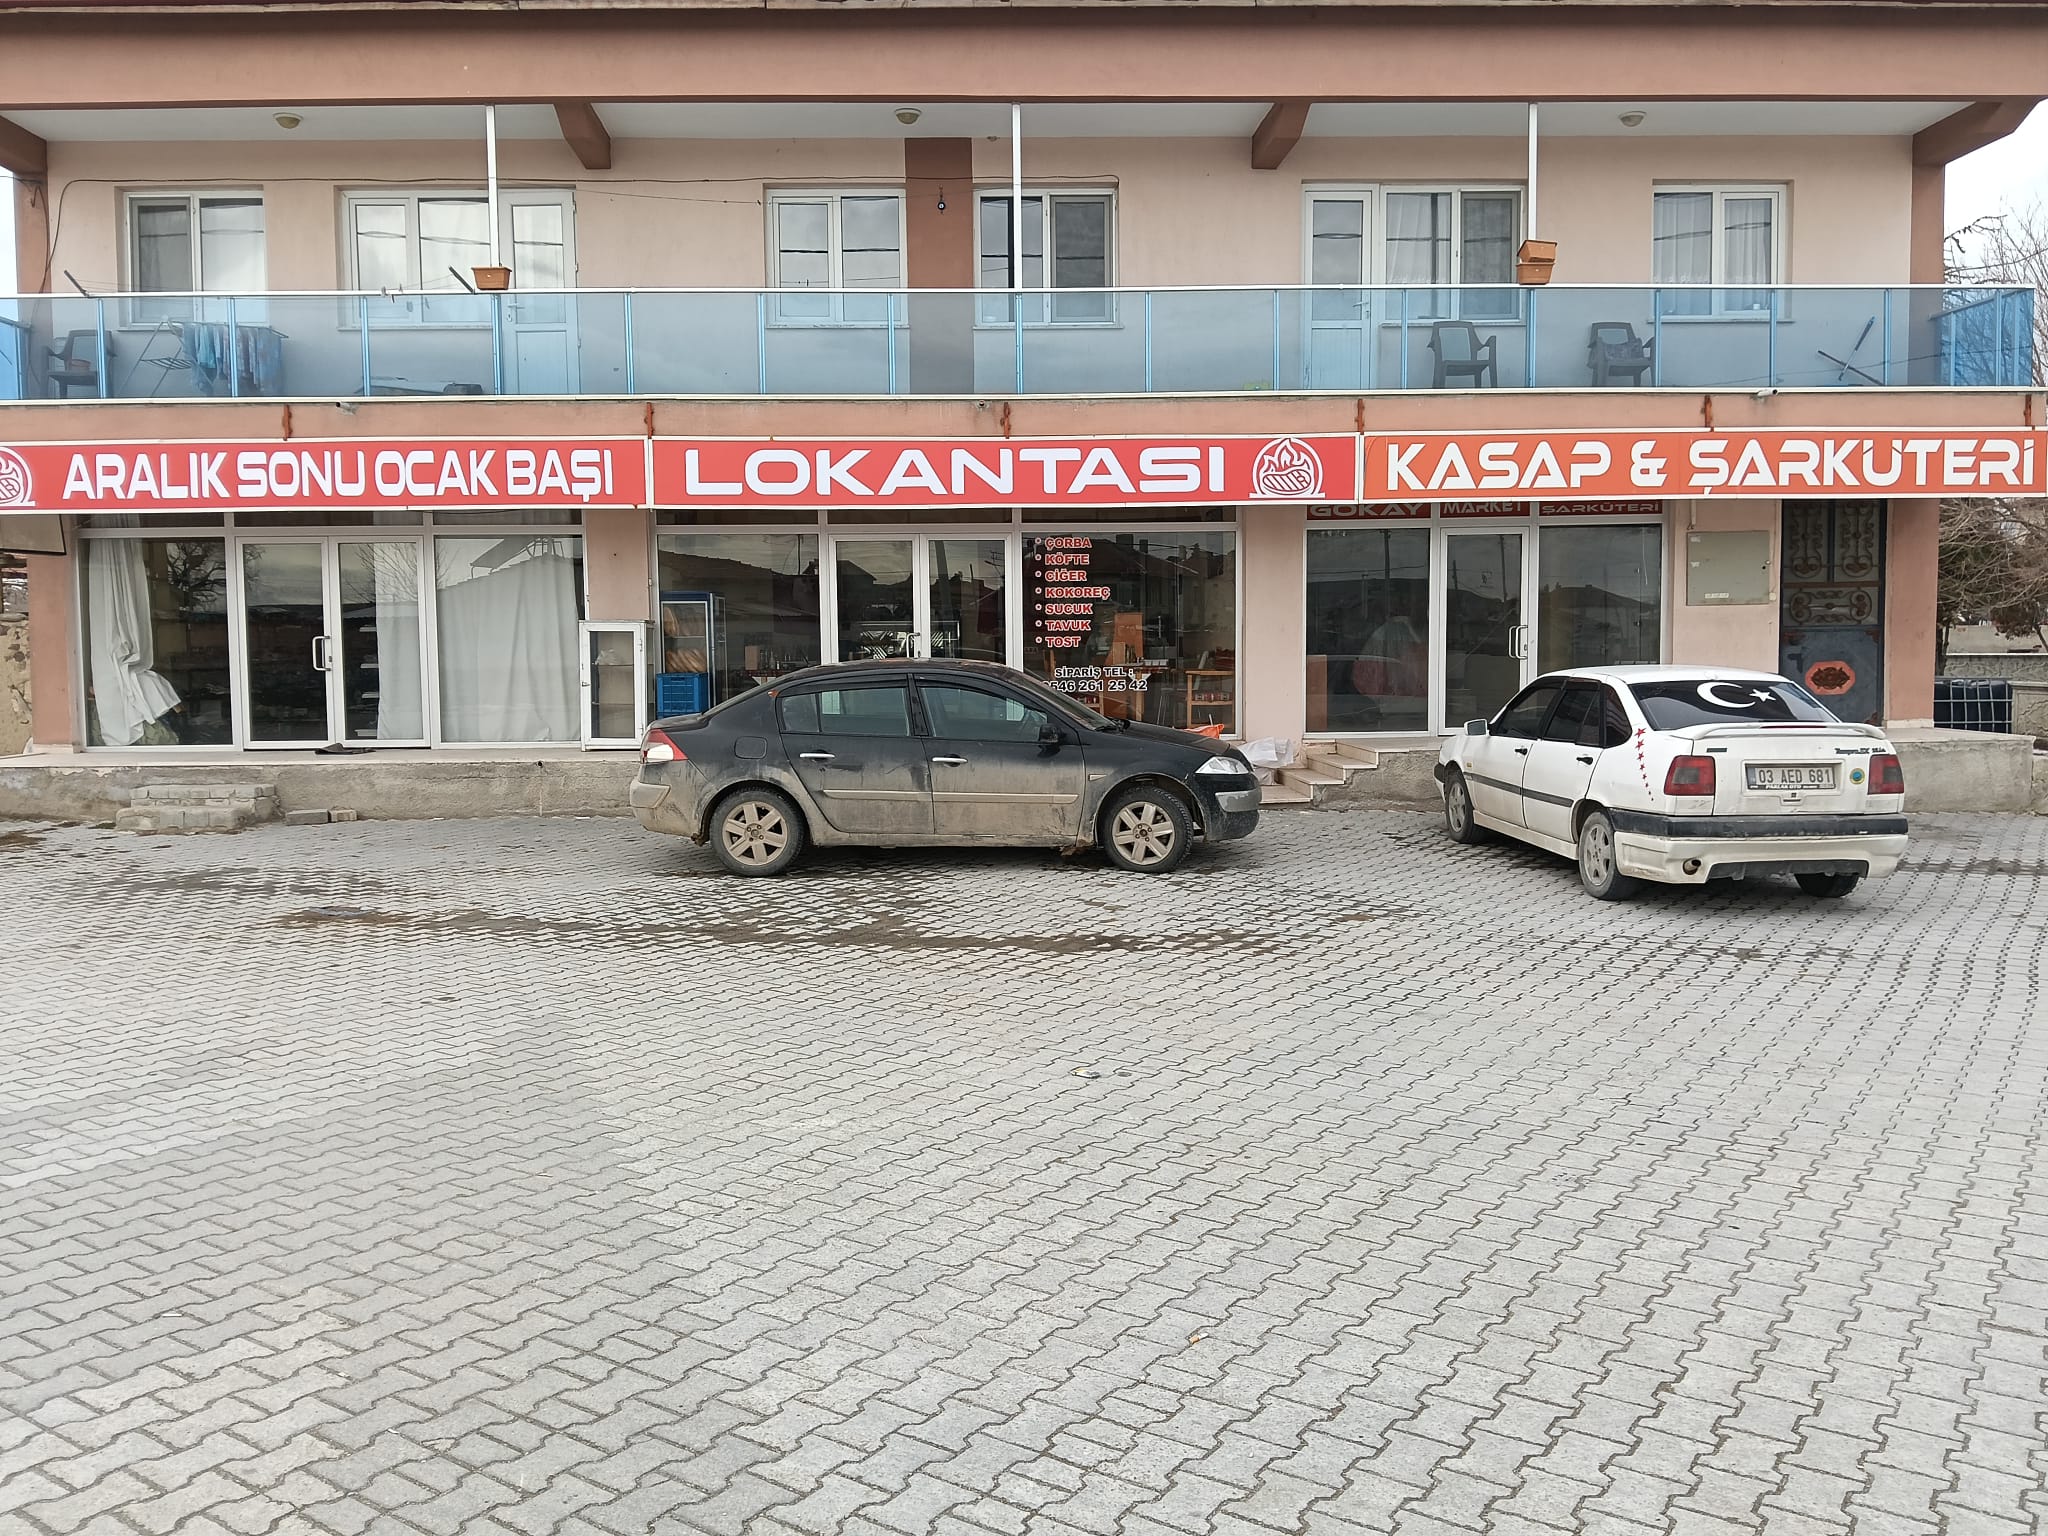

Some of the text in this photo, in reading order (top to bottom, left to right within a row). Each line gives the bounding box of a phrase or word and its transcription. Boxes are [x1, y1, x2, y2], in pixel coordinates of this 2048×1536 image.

[685, 446, 1225, 496] LOKANTASI
[1387, 438, 2035, 495] KASAP & ŞARKÜTERİ
[63, 450, 614, 503] ARALIK SONU OCAK BAŞI
[1045, 536, 1092, 550] ÇORBA
[1045, 552, 1089, 565] KÖFTE
[1045, 569, 1087, 581] CİĞER
[1045, 587, 1110, 600] KOKOREÇ
[1045, 603, 1093, 615] SUCUK
[1045, 620, 1091, 631] TAVUK
[1045, 636, 1081, 647] TOST
[1055, 665, 1101, 679] SİPARİŞ
[1103, 667, 1126, 677] TEL
[1043, 679, 1148, 692] 546 261 25 42
[1759, 769, 1830, 783] 03 AED 681
